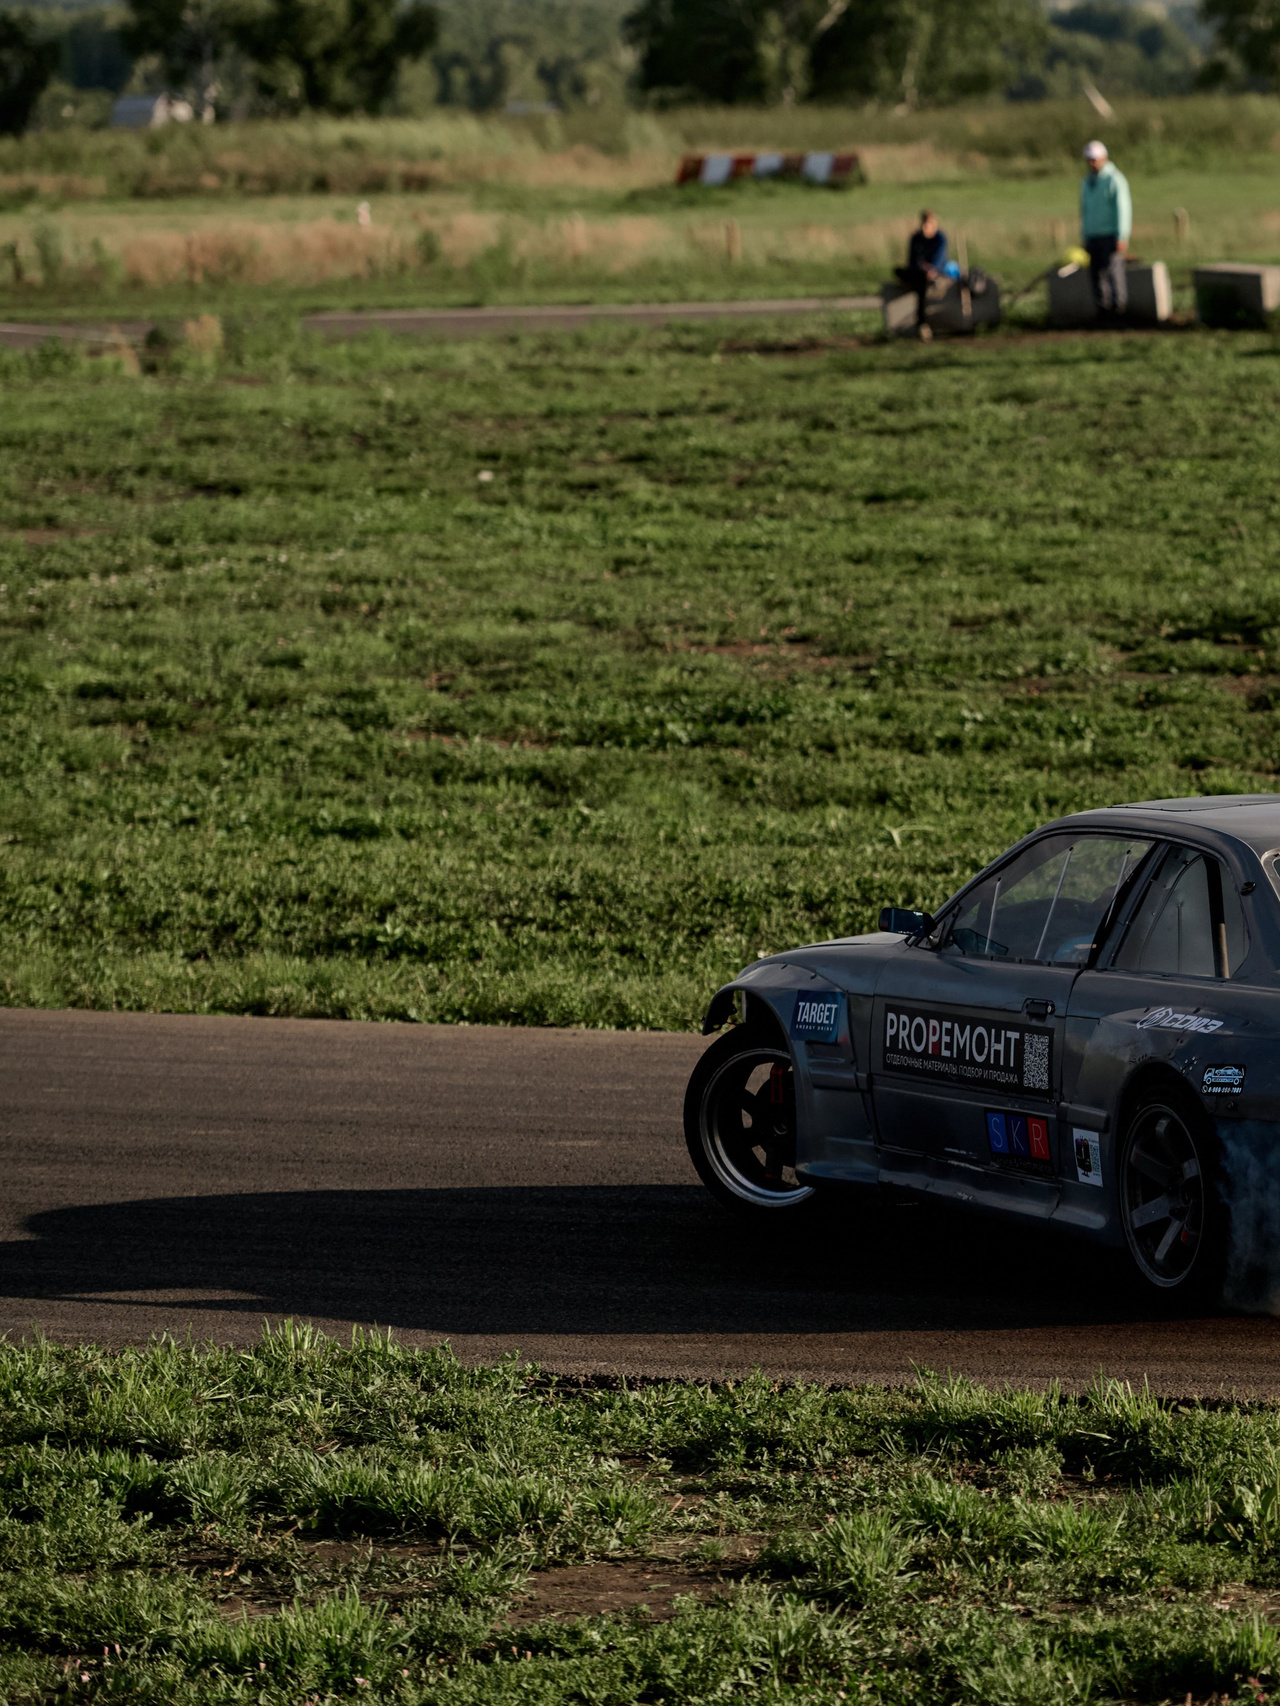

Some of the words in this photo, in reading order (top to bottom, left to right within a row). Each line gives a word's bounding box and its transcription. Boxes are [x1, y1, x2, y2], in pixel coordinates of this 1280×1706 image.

[797, 1001, 838, 1024] TARGET
[886, 1053, 922, 1067] ОТДЕЛОЧНЫЕ
[958, 1065, 983, 1079] ПОДБОР
[983, 1069, 988, 1080] И
[989, 1070, 1019, 1084] ПРОДАЖА
[991, 1117, 1045, 1155] SKR
